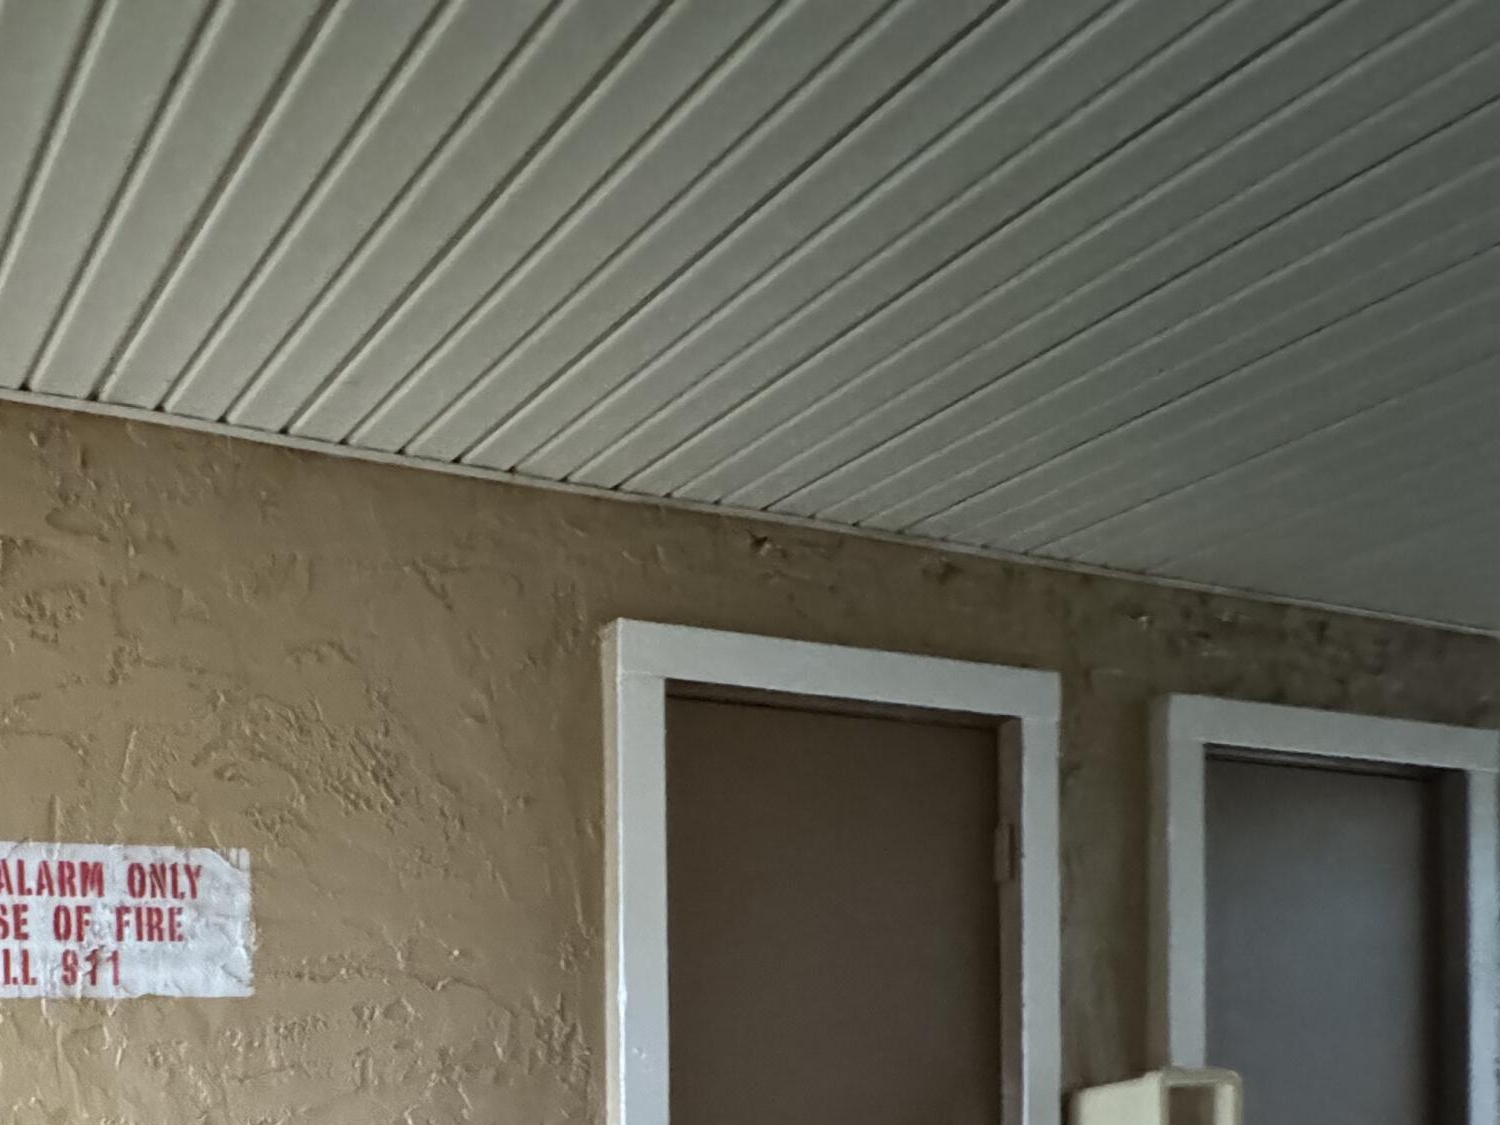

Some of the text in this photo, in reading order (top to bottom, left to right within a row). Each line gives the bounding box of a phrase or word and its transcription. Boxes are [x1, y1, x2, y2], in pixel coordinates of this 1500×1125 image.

[126, 862, 202, 900] ONLY
[52, 904, 92, 942] OF
[115, 906, 183, 943] FIRE
[61, 949, 121, 987] 911
